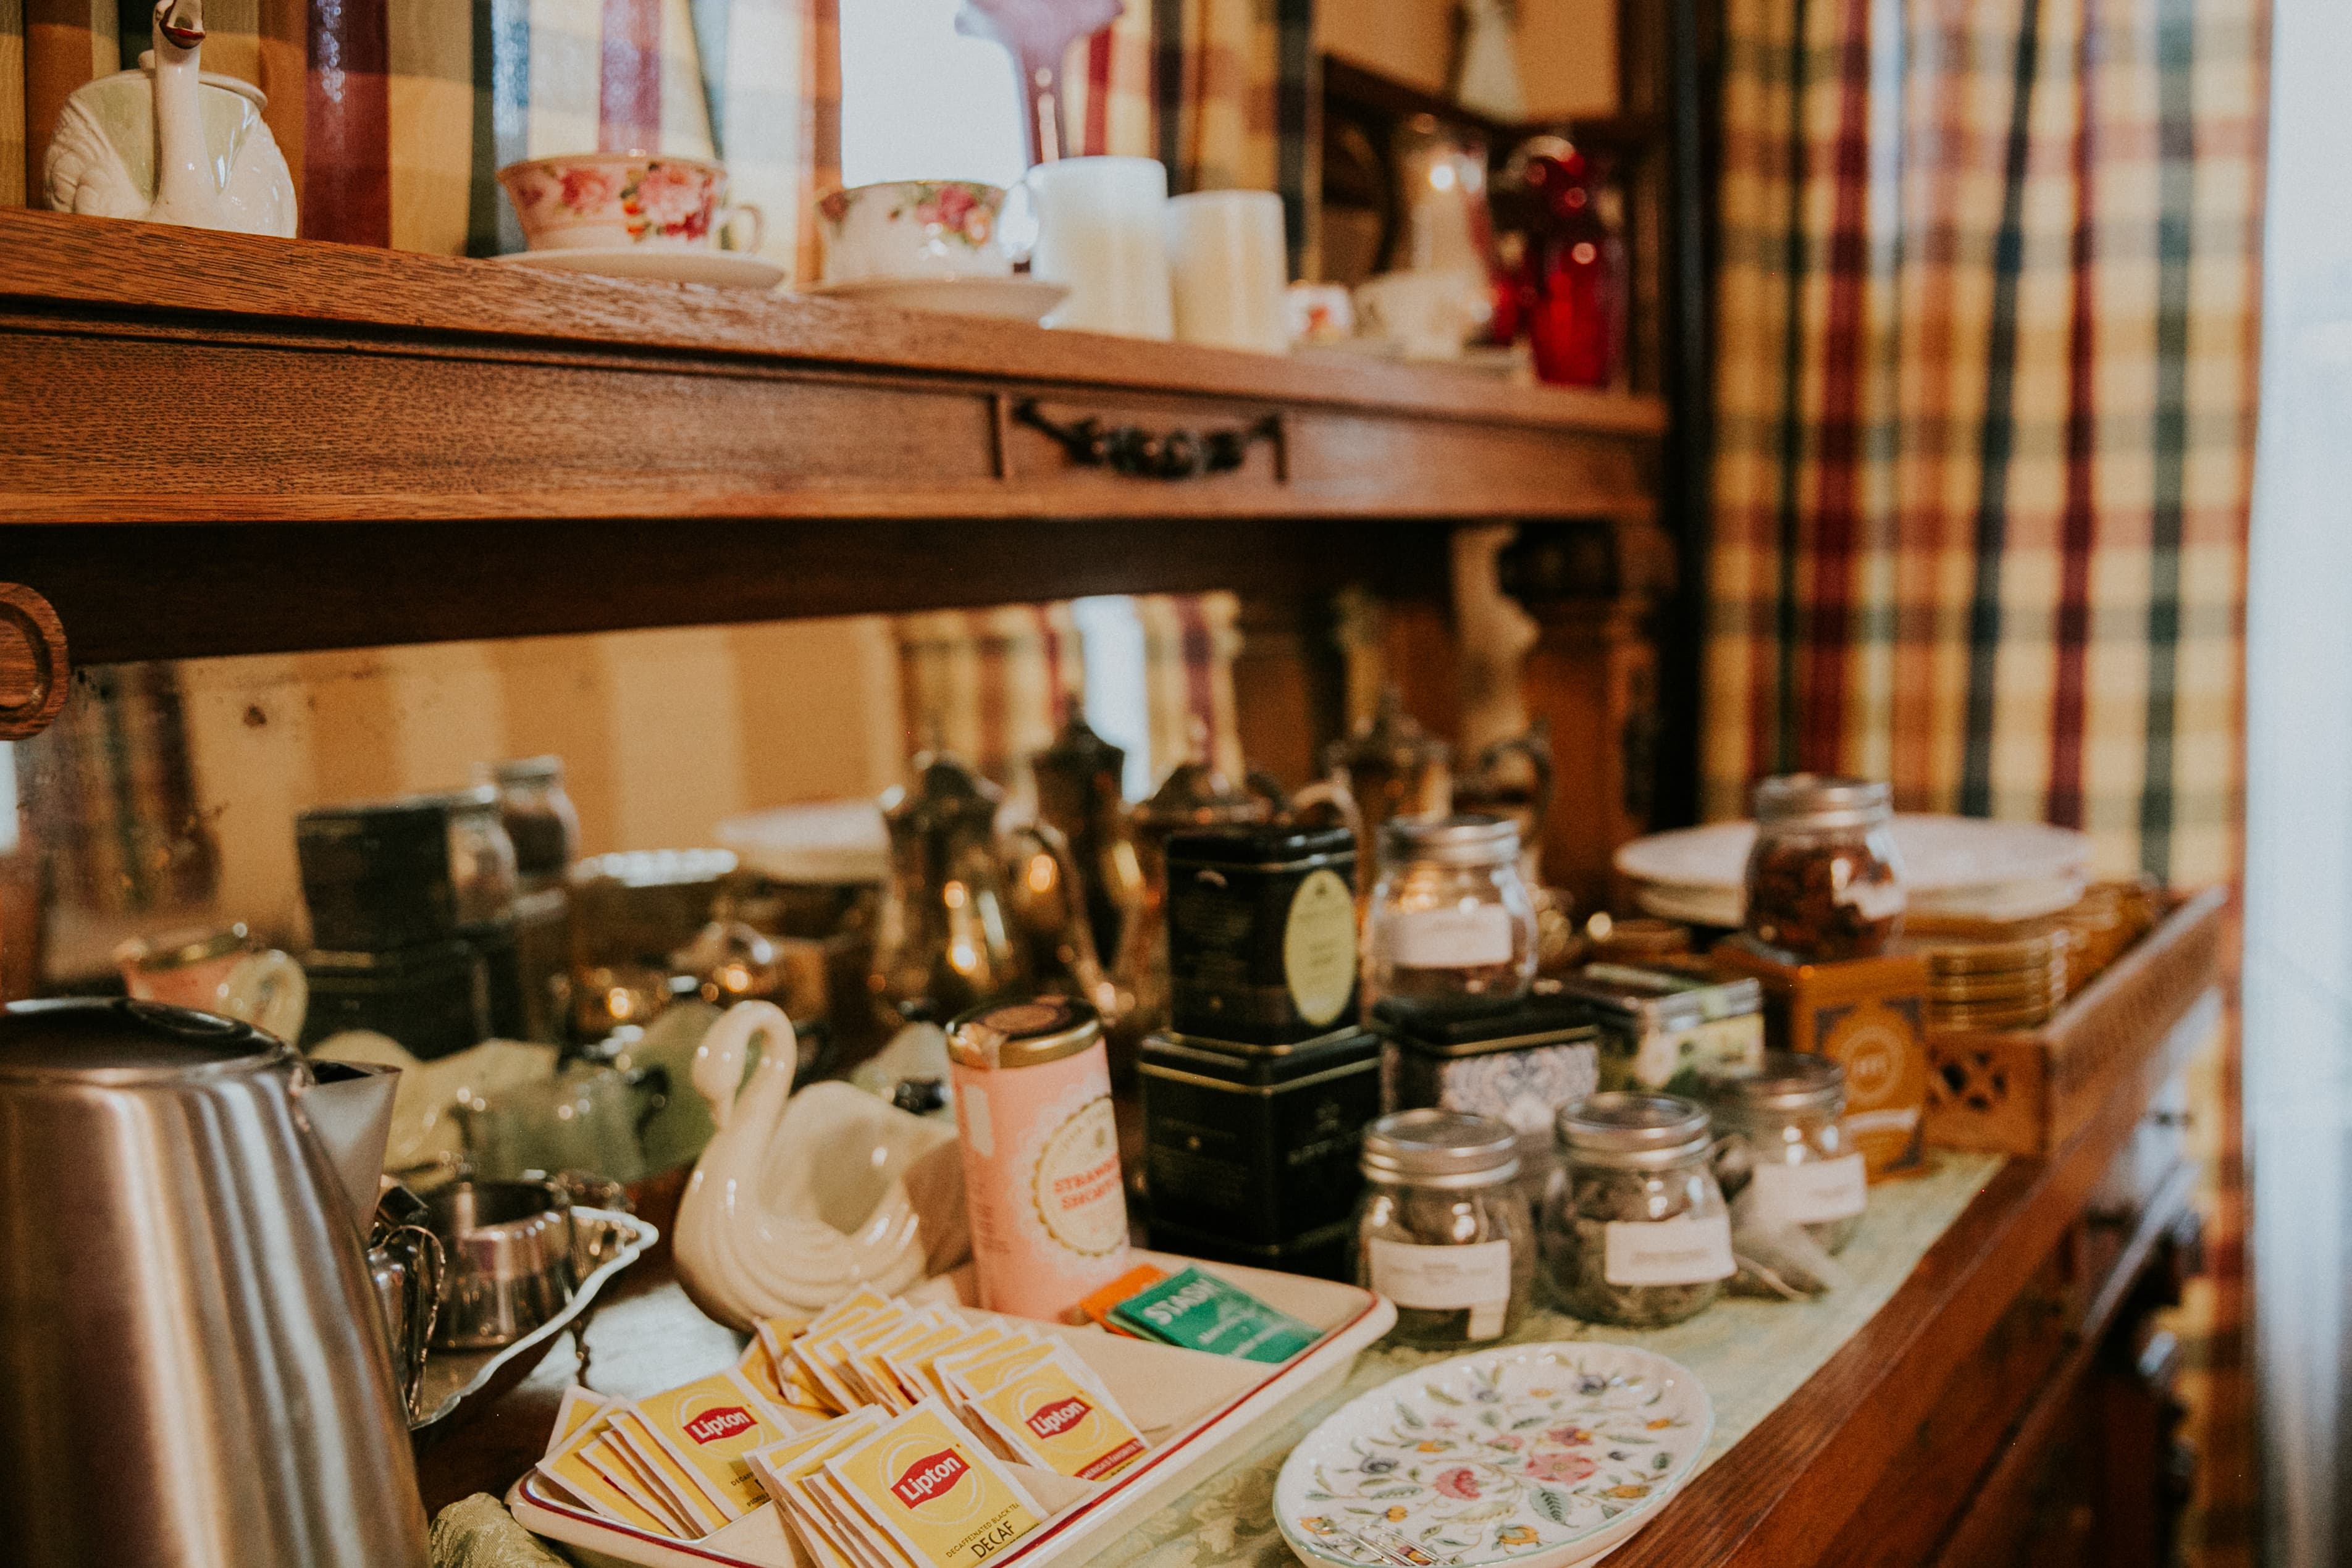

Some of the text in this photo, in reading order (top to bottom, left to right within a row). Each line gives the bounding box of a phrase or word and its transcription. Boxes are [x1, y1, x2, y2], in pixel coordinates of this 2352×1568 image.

[1143, 1278, 1223, 1325] STASH
[691, 1411, 750, 1440] Lipton
[1031, 1401, 1085, 1435] Lipton
[899, 1457, 961, 1501] Lipton
[946, 1522, 993, 1558] DECAFFEINATED
[991, 1509, 1012, 1524] BLACK
[970, 1520, 1014, 1559] DECAF
